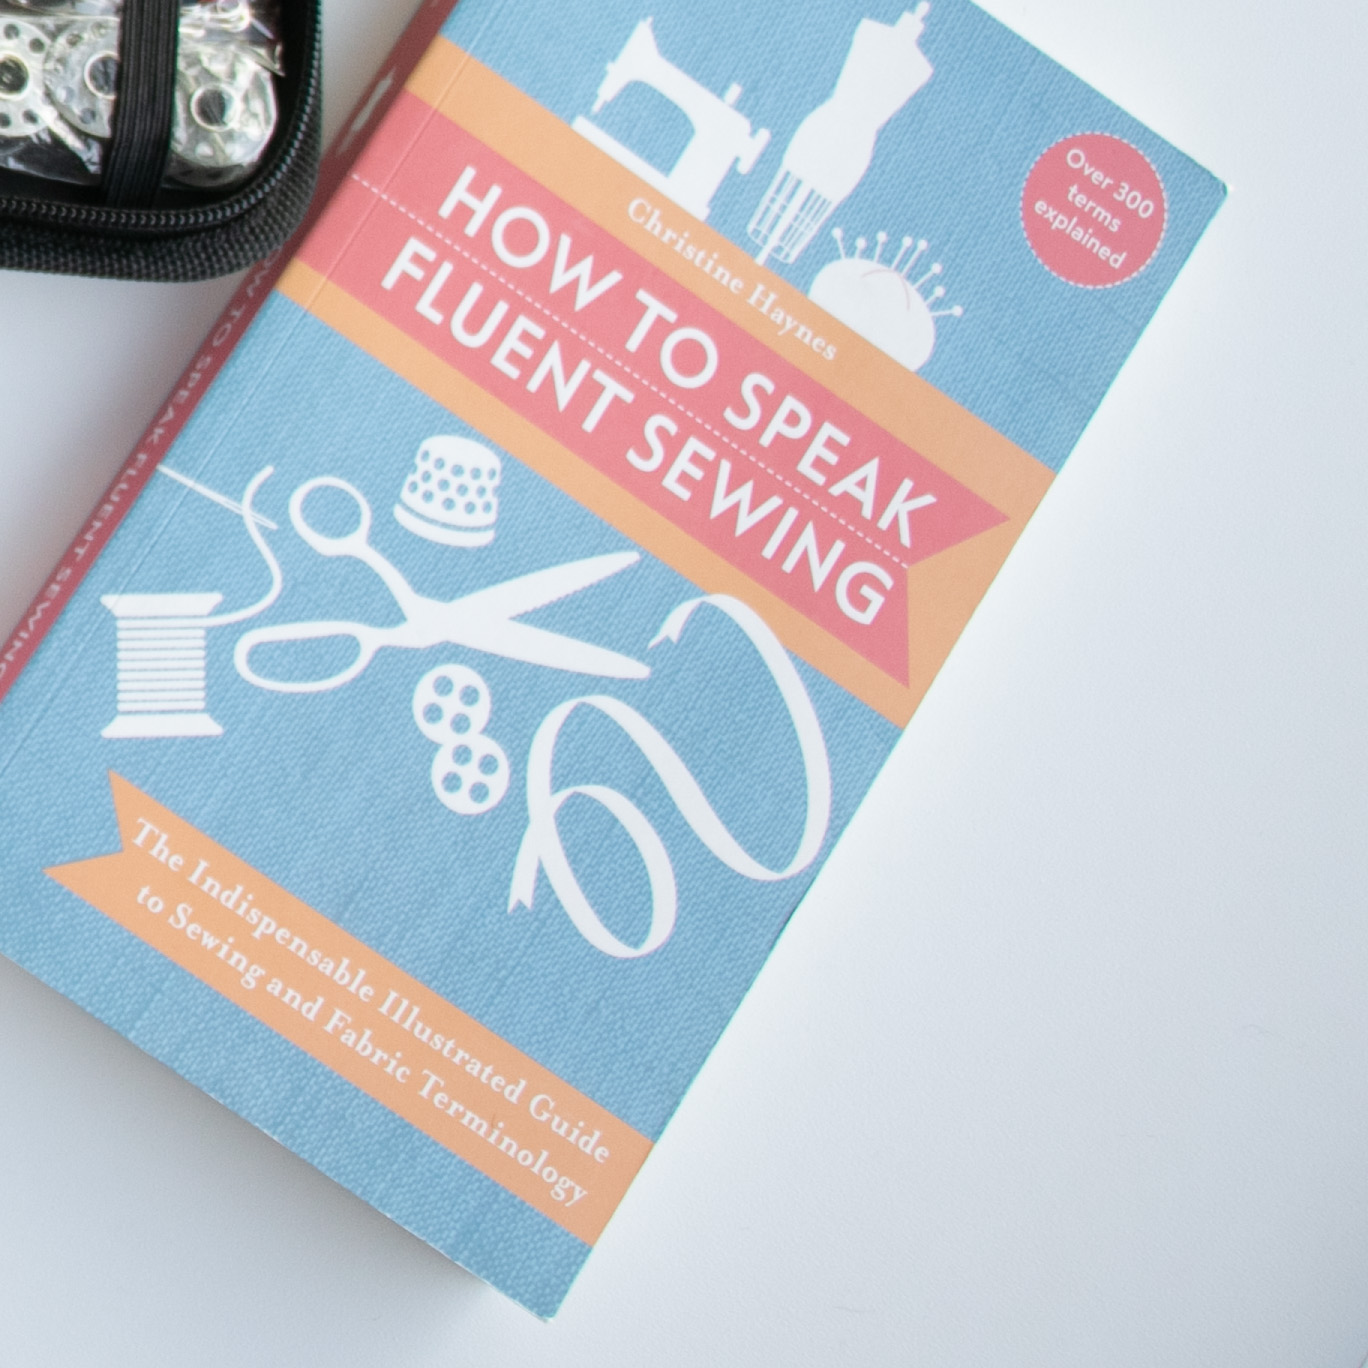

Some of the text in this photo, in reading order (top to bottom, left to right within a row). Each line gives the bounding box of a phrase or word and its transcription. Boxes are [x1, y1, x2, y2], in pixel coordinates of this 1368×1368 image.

[1031, 197, 1129, 272] explained
[1063, 146, 1157, 221] Over 300
[1064, 182, 1123, 235] terms
[626, 196, 838, 362] Christine Haynes
[145, 356, 210, 445] SPEAK
[437, 165, 937, 548] HOW TO SPEAK
[380, 236, 894, 625] FLUENT SEWING
[65, 446, 151, 563] FLUENT
[132, 816, 611, 1164] The Indispensable Illustrated Guide
[135, 884, 589, 1209] to Sewing and Fabric Terminology
